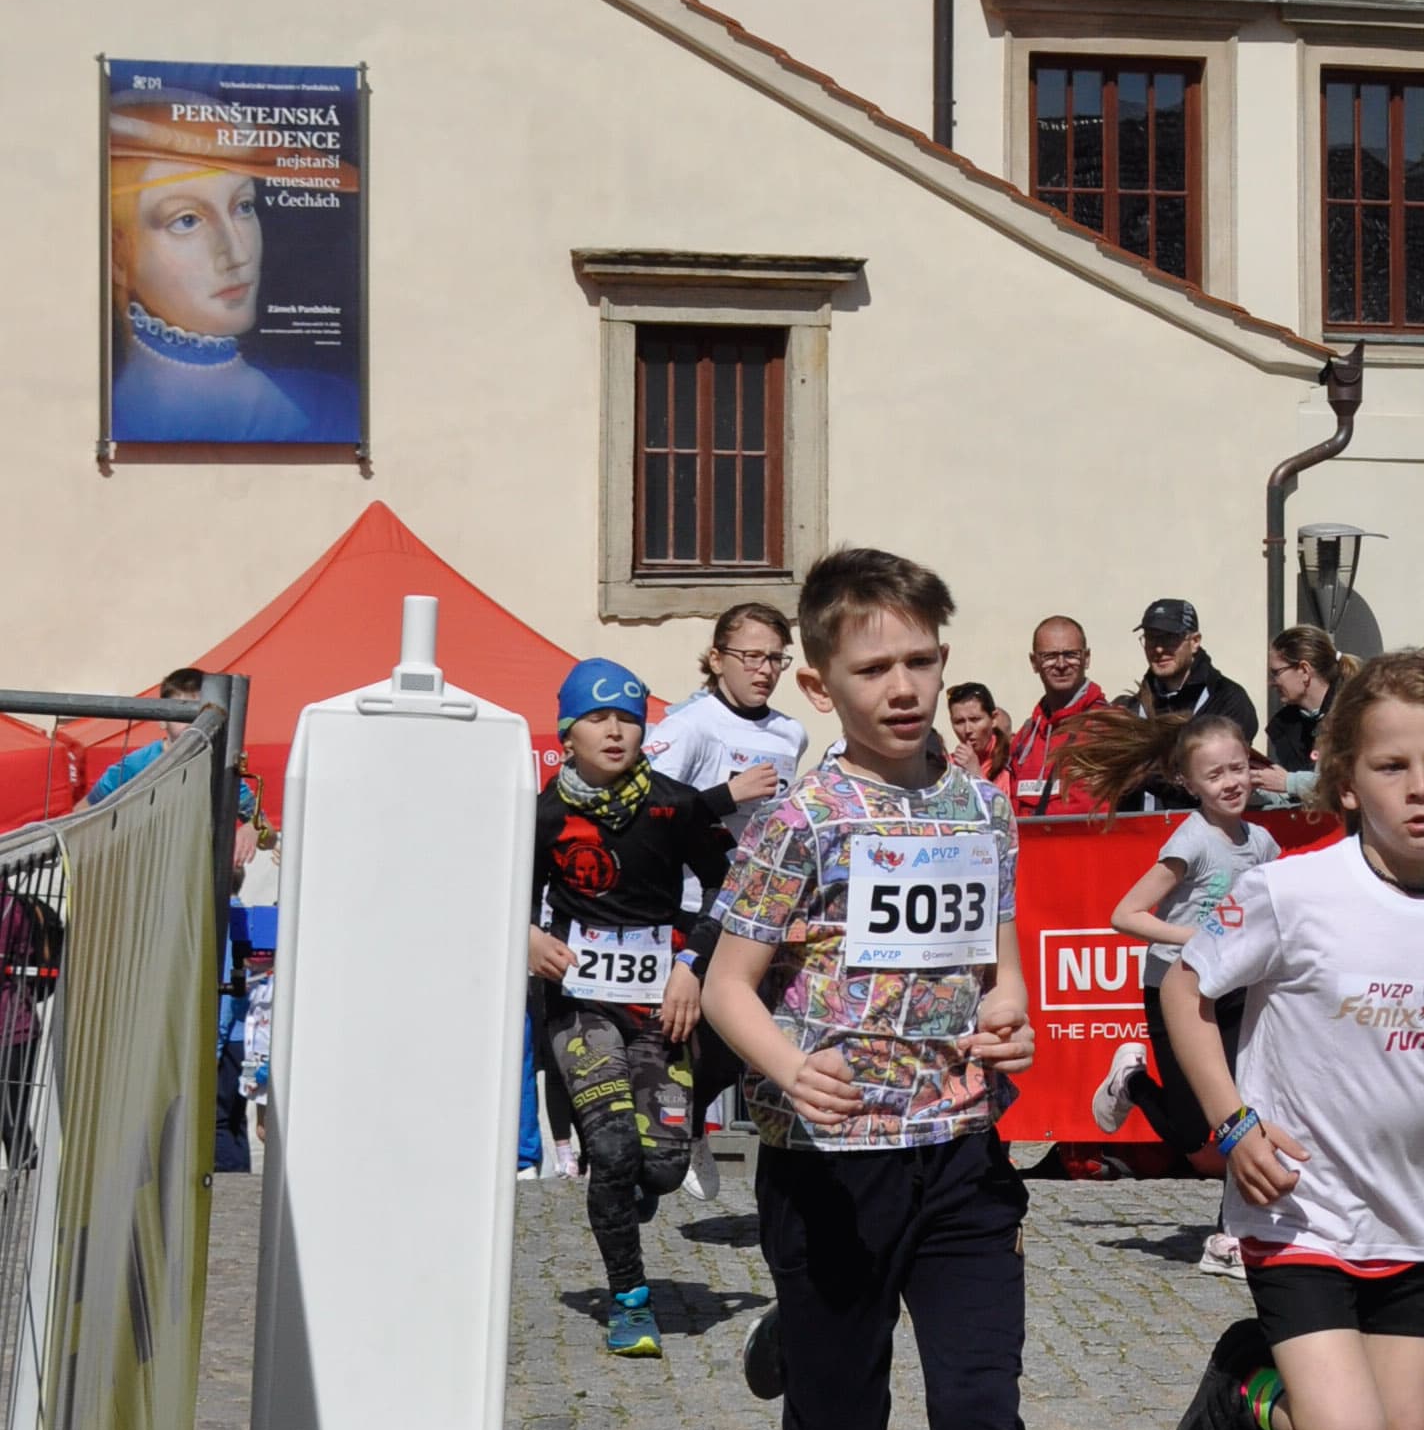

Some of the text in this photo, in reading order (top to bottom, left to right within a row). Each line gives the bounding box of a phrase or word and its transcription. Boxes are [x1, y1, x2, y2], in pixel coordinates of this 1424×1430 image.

[171, 102, 340, 126] PERNŠTEJNSKÁ
[216, 128, 340, 149] REZIDENCE
[276, 154, 340, 170] nejstarší
[265, 175, 340, 188] renesance
[264, 190, 340, 208] v Čechách
[932, 847, 960, 859] PVZP
[868, 882, 986, 934] 5033
[873, 950, 901, 959] PVZP
[578, 950, 657, 983] 2138
[1368, 982, 1413, 998] PVZP
[1329, 994, 1422, 1029] Fénix
[1047, 1023, 1084, 1039] THE
